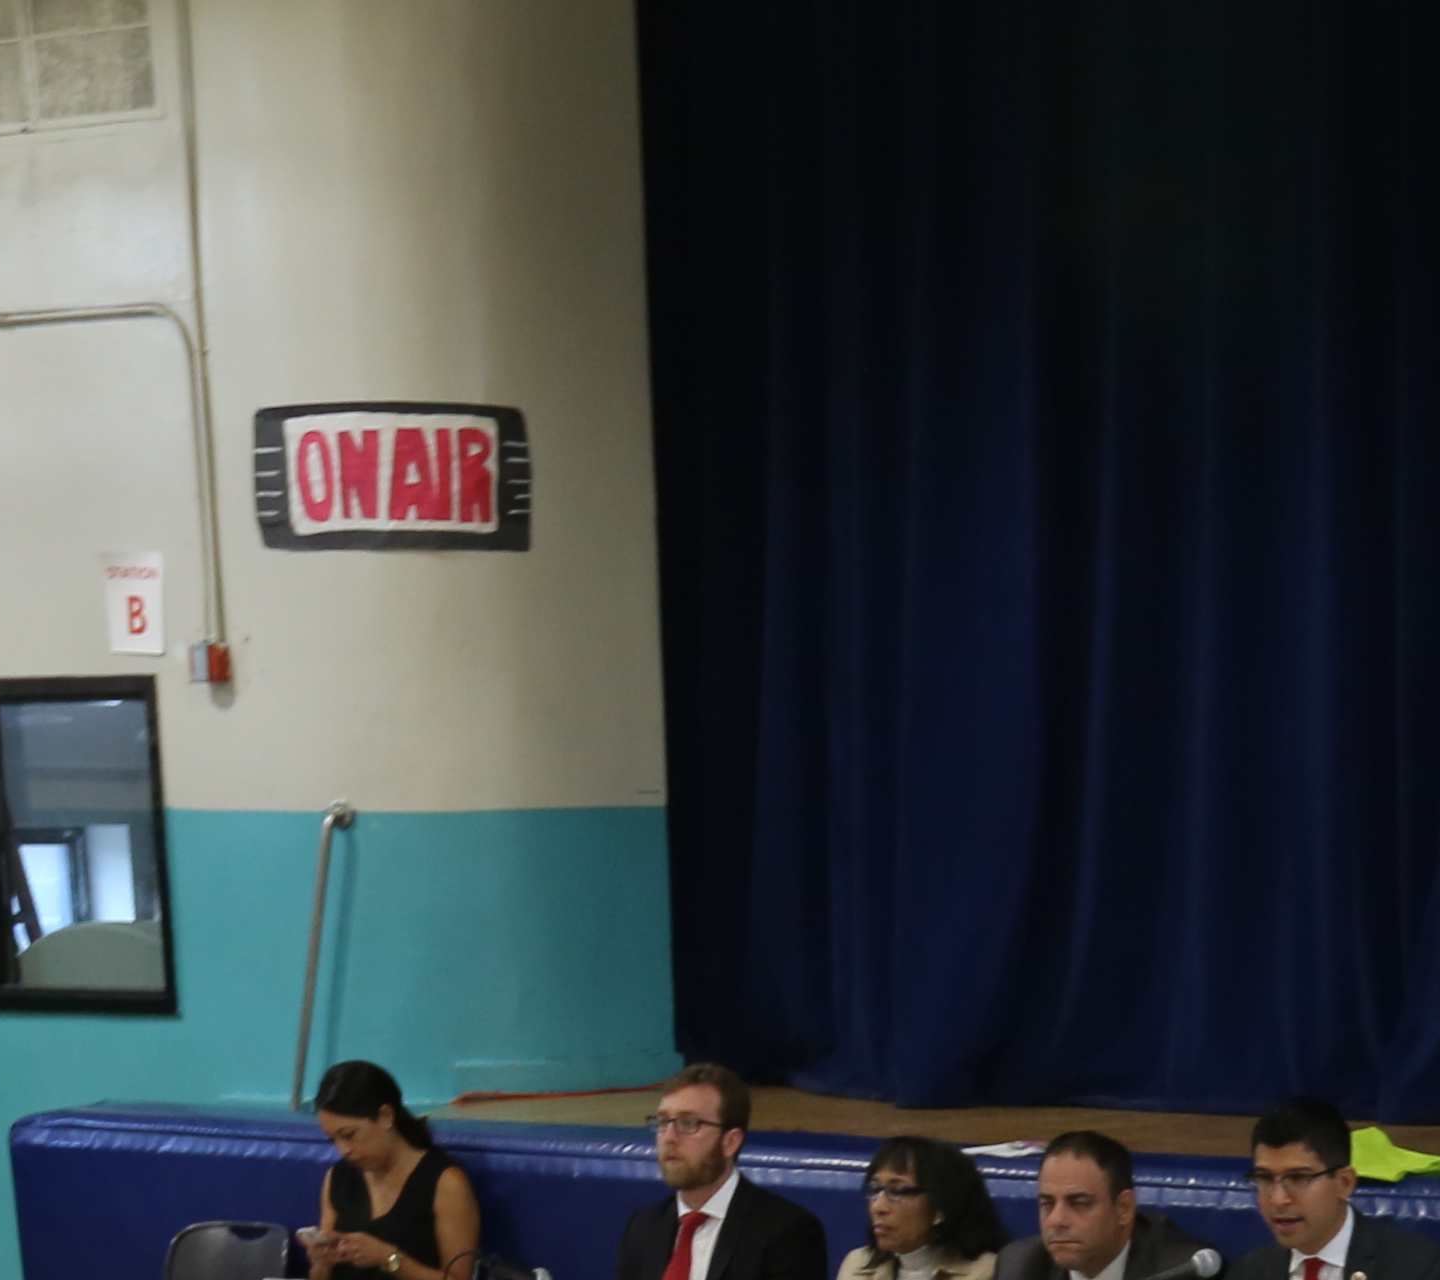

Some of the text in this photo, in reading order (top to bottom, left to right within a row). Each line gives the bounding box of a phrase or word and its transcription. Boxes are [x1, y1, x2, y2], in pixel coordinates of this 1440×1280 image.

[297, 427, 493, 523] ON AIR
[128, 595, 147, 635] B
